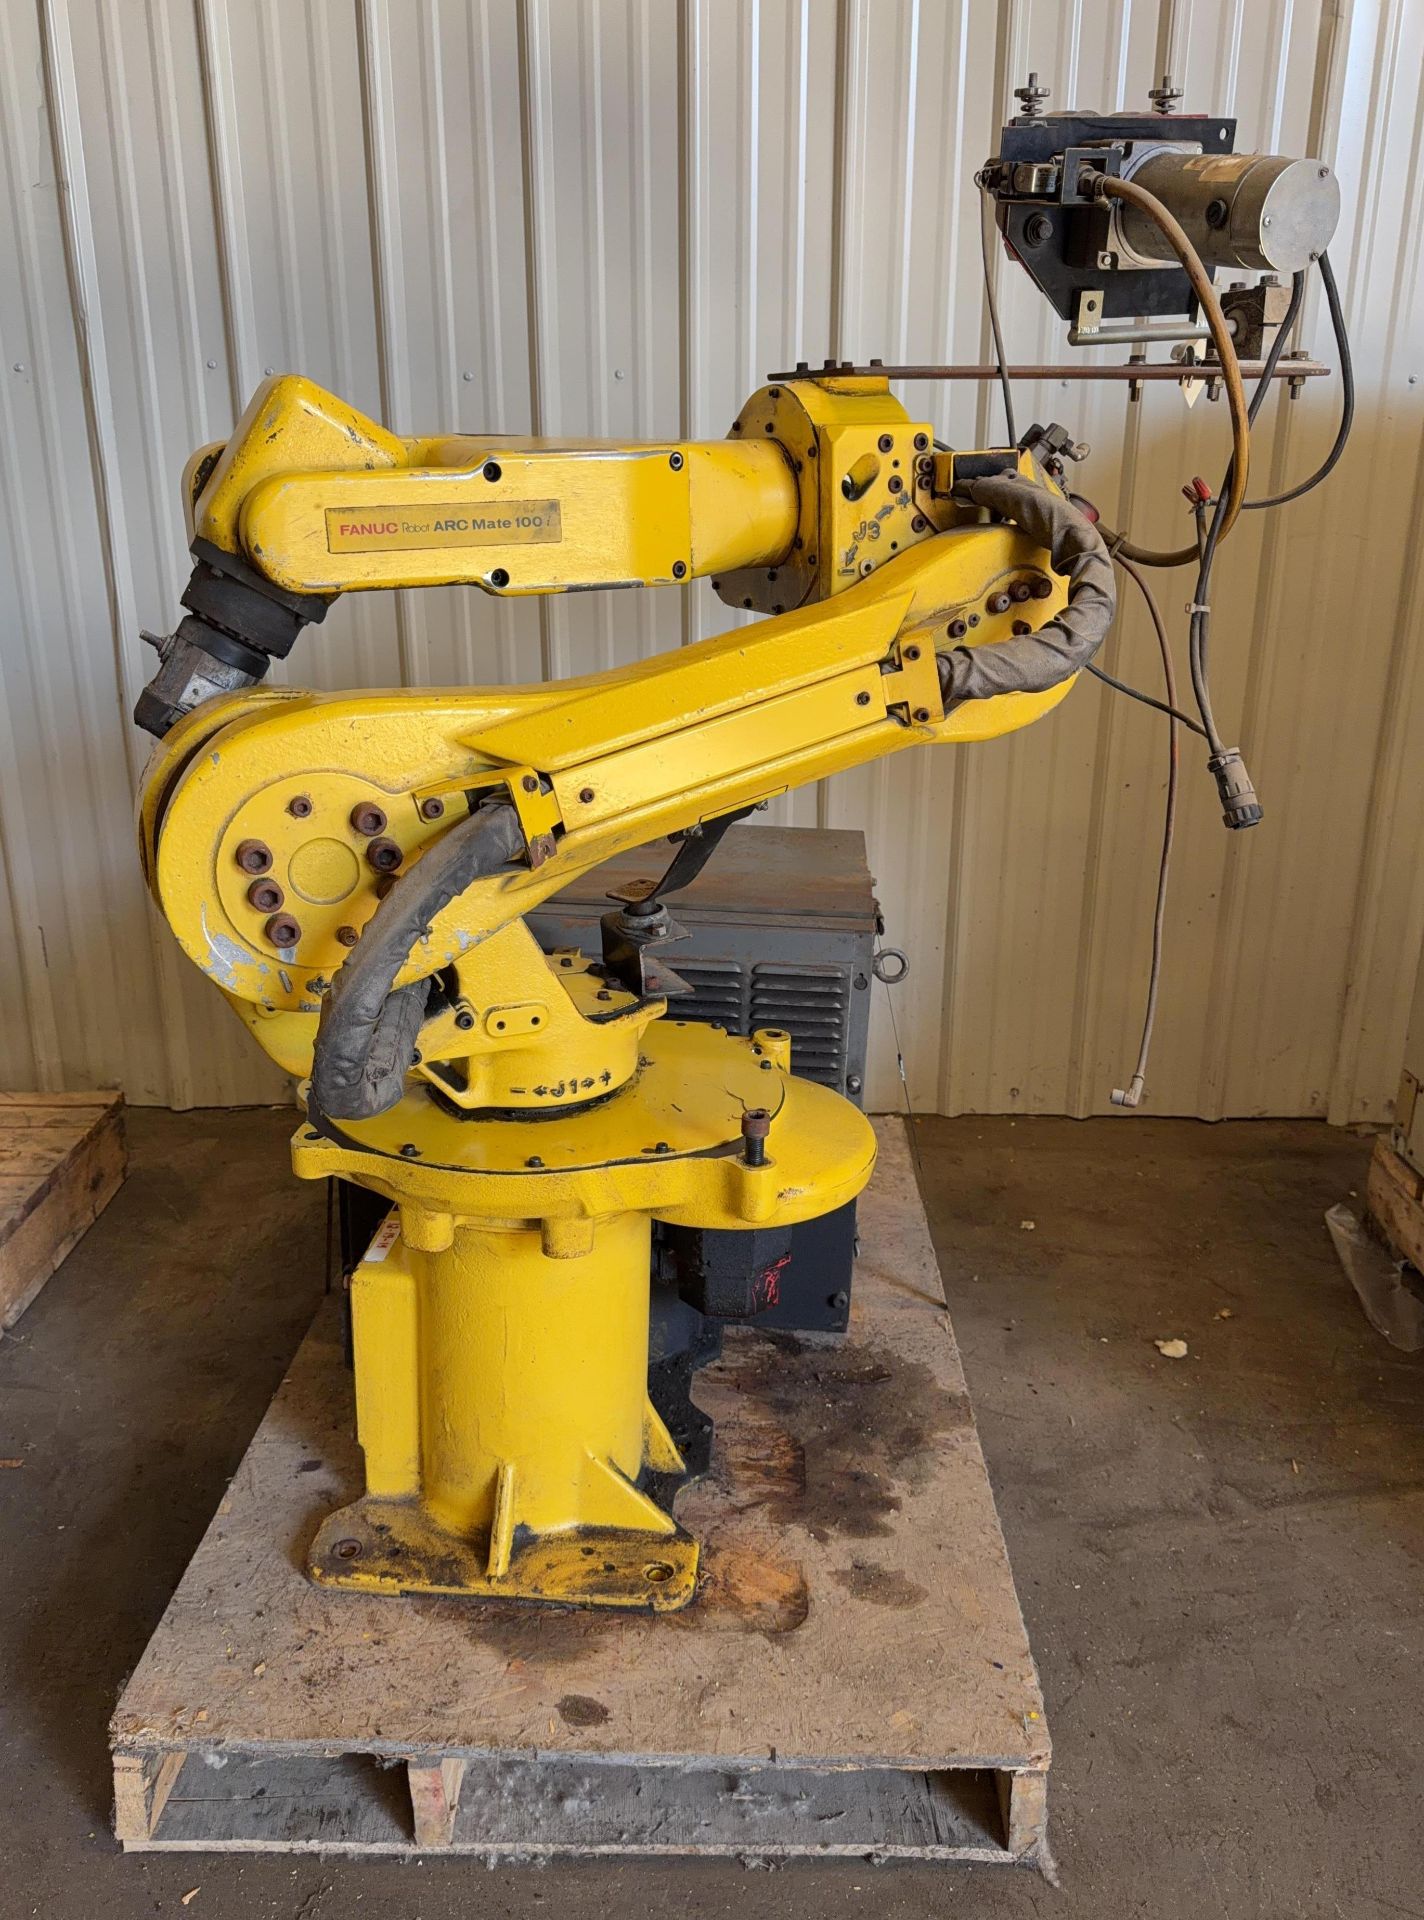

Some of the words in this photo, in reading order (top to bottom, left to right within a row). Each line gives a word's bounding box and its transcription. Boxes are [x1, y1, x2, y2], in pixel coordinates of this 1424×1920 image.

[340, 522, 399, 536] FANUC
[402, 522, 430, 534] Robot
[434, 519, 469, 532] ARC
[472, 518, 512, 531] Mate
[515, 516, 543, 529] 100
[853, 520, 881, 542] J3
[550, 1078, 578, 1098] J1
